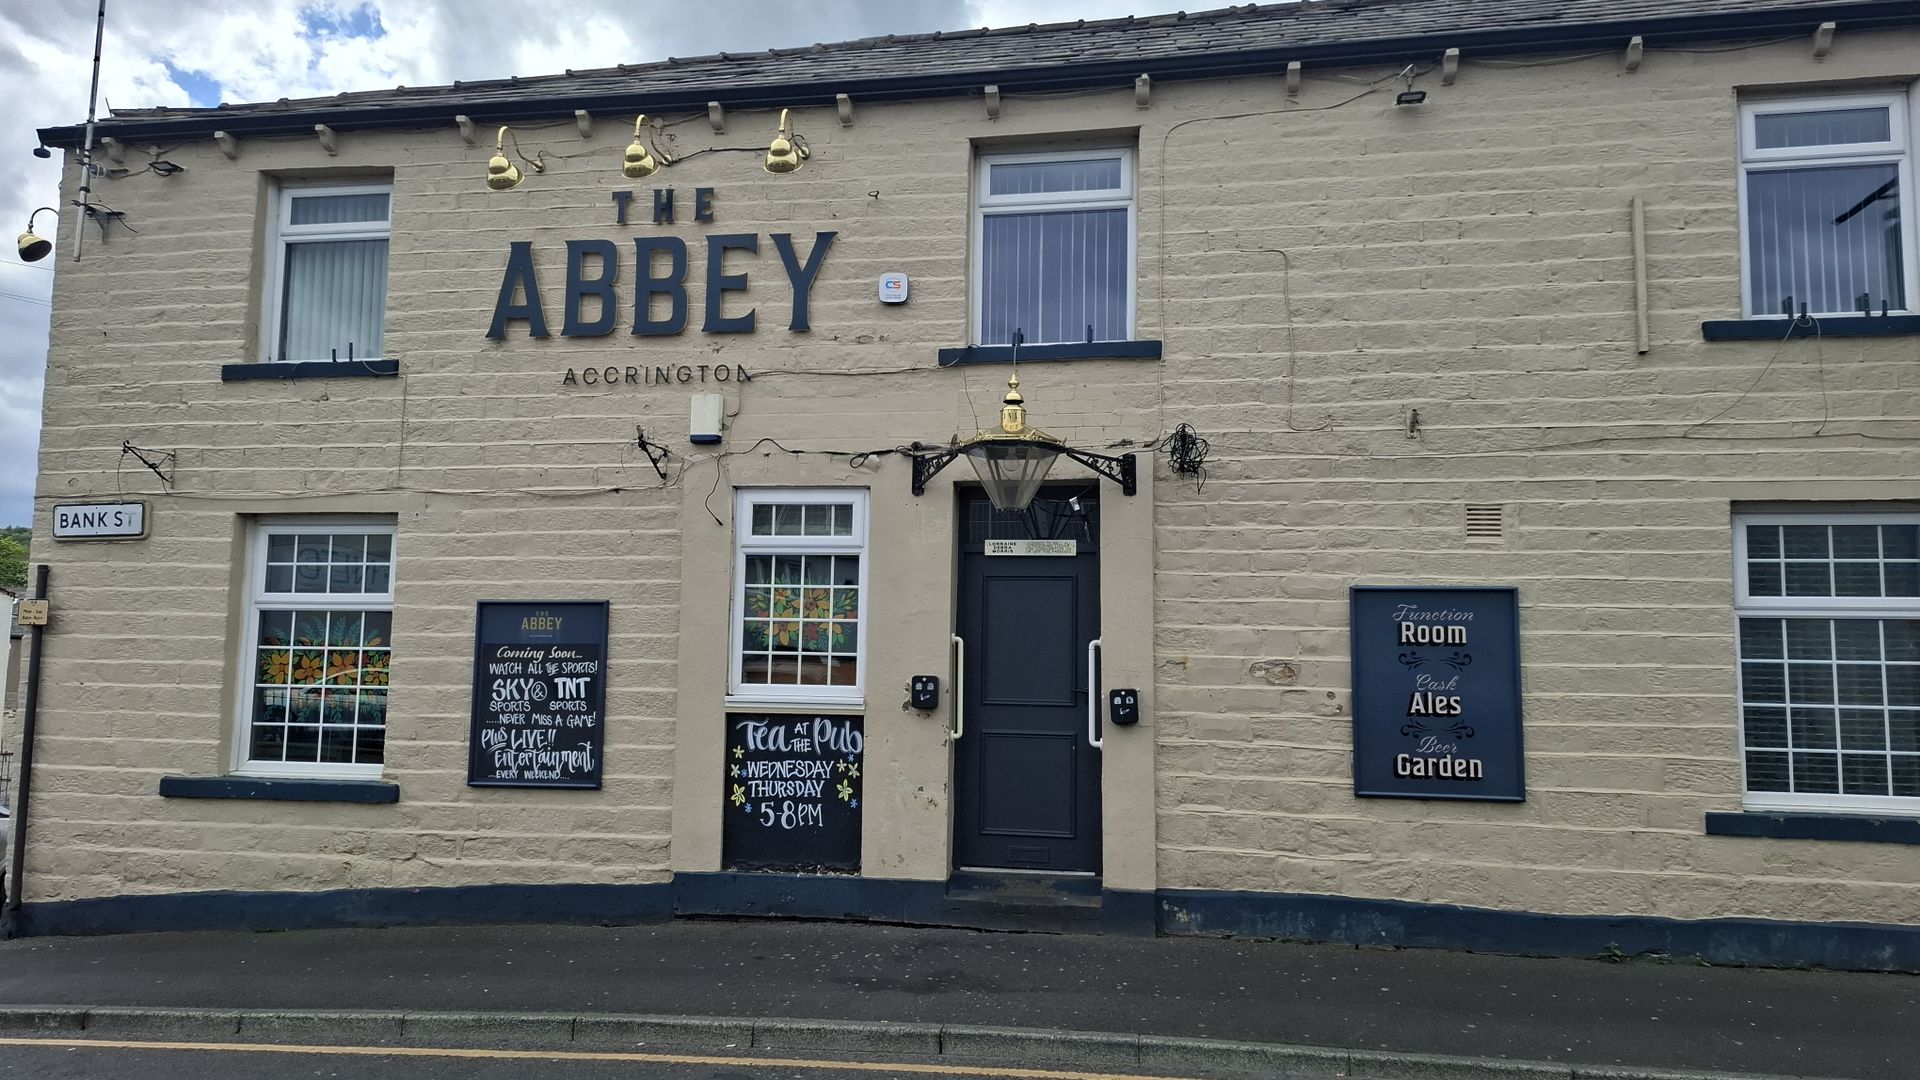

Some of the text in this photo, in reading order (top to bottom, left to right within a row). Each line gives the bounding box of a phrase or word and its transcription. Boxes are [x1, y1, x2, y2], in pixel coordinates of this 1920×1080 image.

[612, 187, 715, 224] THE
[485, 231, 838, 338] ABBEY
[563, 364, 752, 386] ACCRINGTON
[60, 511, 136, 528] BANK ST
[1392, 604, 1474, 621] Function
[521, 617, 563, 630] ABBEY
[1400, 622, 1467, 644] Room
[497, 646, 545, 663] Coming
[489, 662, 523, 675] WATCH
[527, 663, 543, 675] ALL
[561, 660, 598, 675] SPORTS!
[491, 678, 534, 700] SKY
[554, 677, 590, 699] TNT
[1416, 674, 1460, 691] Cask
[489, 700, 587, 712] SPORTS SPORTS
[1410, 692, 1462, 715] Ales
[531, 713, 552, 726] MISS
[555, 714, 563, 727] A
[566, 711, 596, 729] GAME!
[511, 728, 557, 749] LIVE!!
[736, 717, 863, 755] Tea AT THE Pub
[1416, 736, 1458, 753] Beer
[494, 741, 595, 773] Entertainment
[1397, 753, 1483, 778] Garden
[747, 760, 834, 778] WEDNESDAY
[748, 779, 825, 798] THURSDAY
